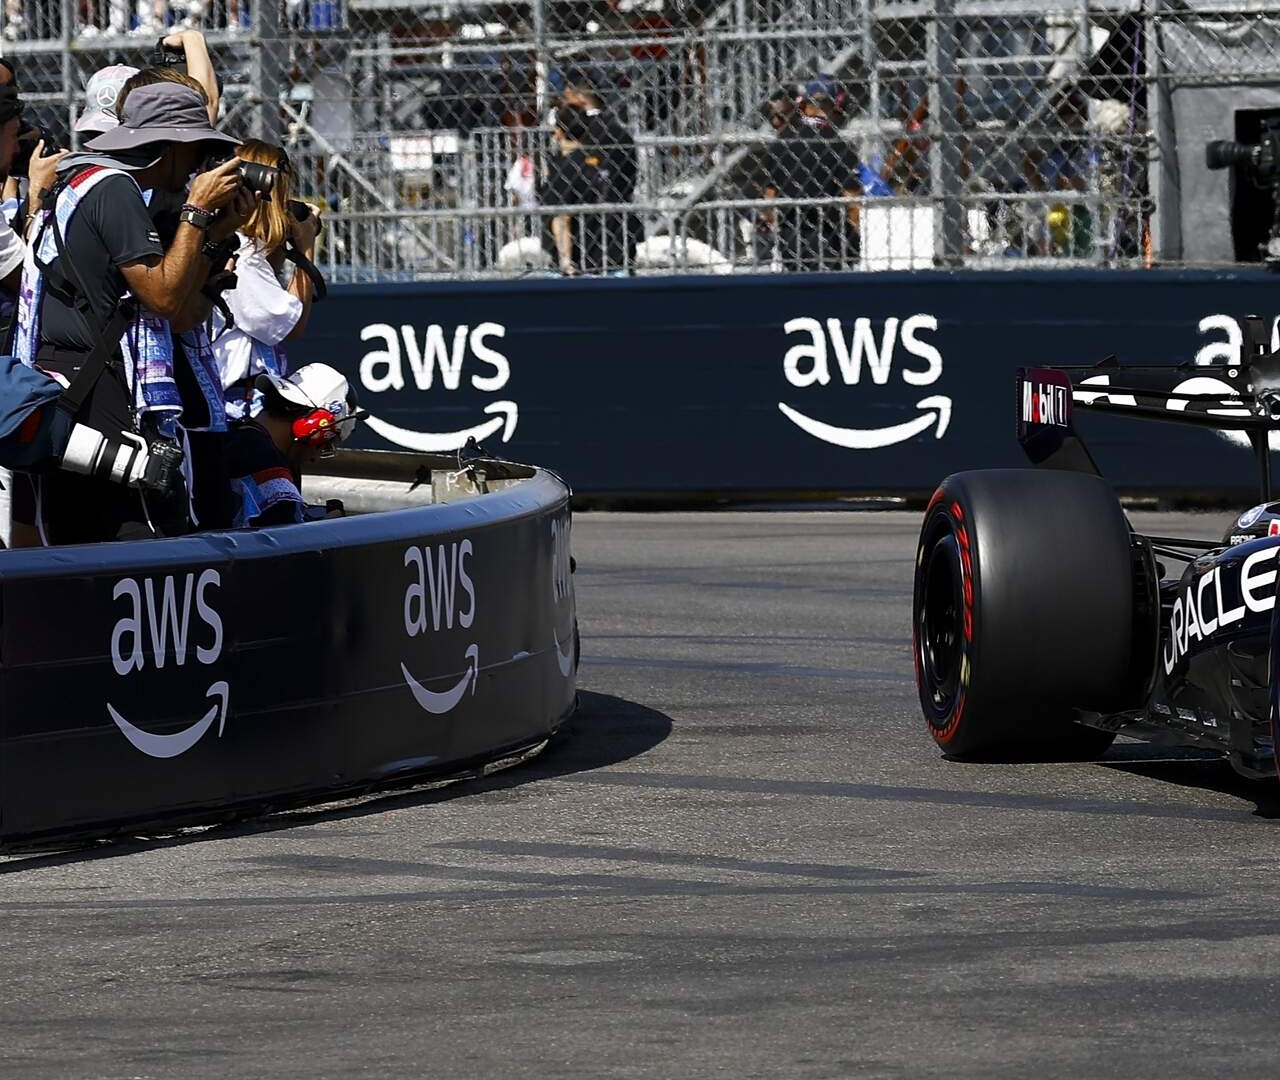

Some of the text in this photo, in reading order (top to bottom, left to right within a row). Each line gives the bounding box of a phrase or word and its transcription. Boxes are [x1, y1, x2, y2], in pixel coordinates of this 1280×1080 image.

[360, 323, 510, 393] aws
[785, 314, 944, 387] aws
[1023, 381, 1055, 425] Mobil
[111, 568, 224, 676] aws
[405, 538, 476, 637] aws
